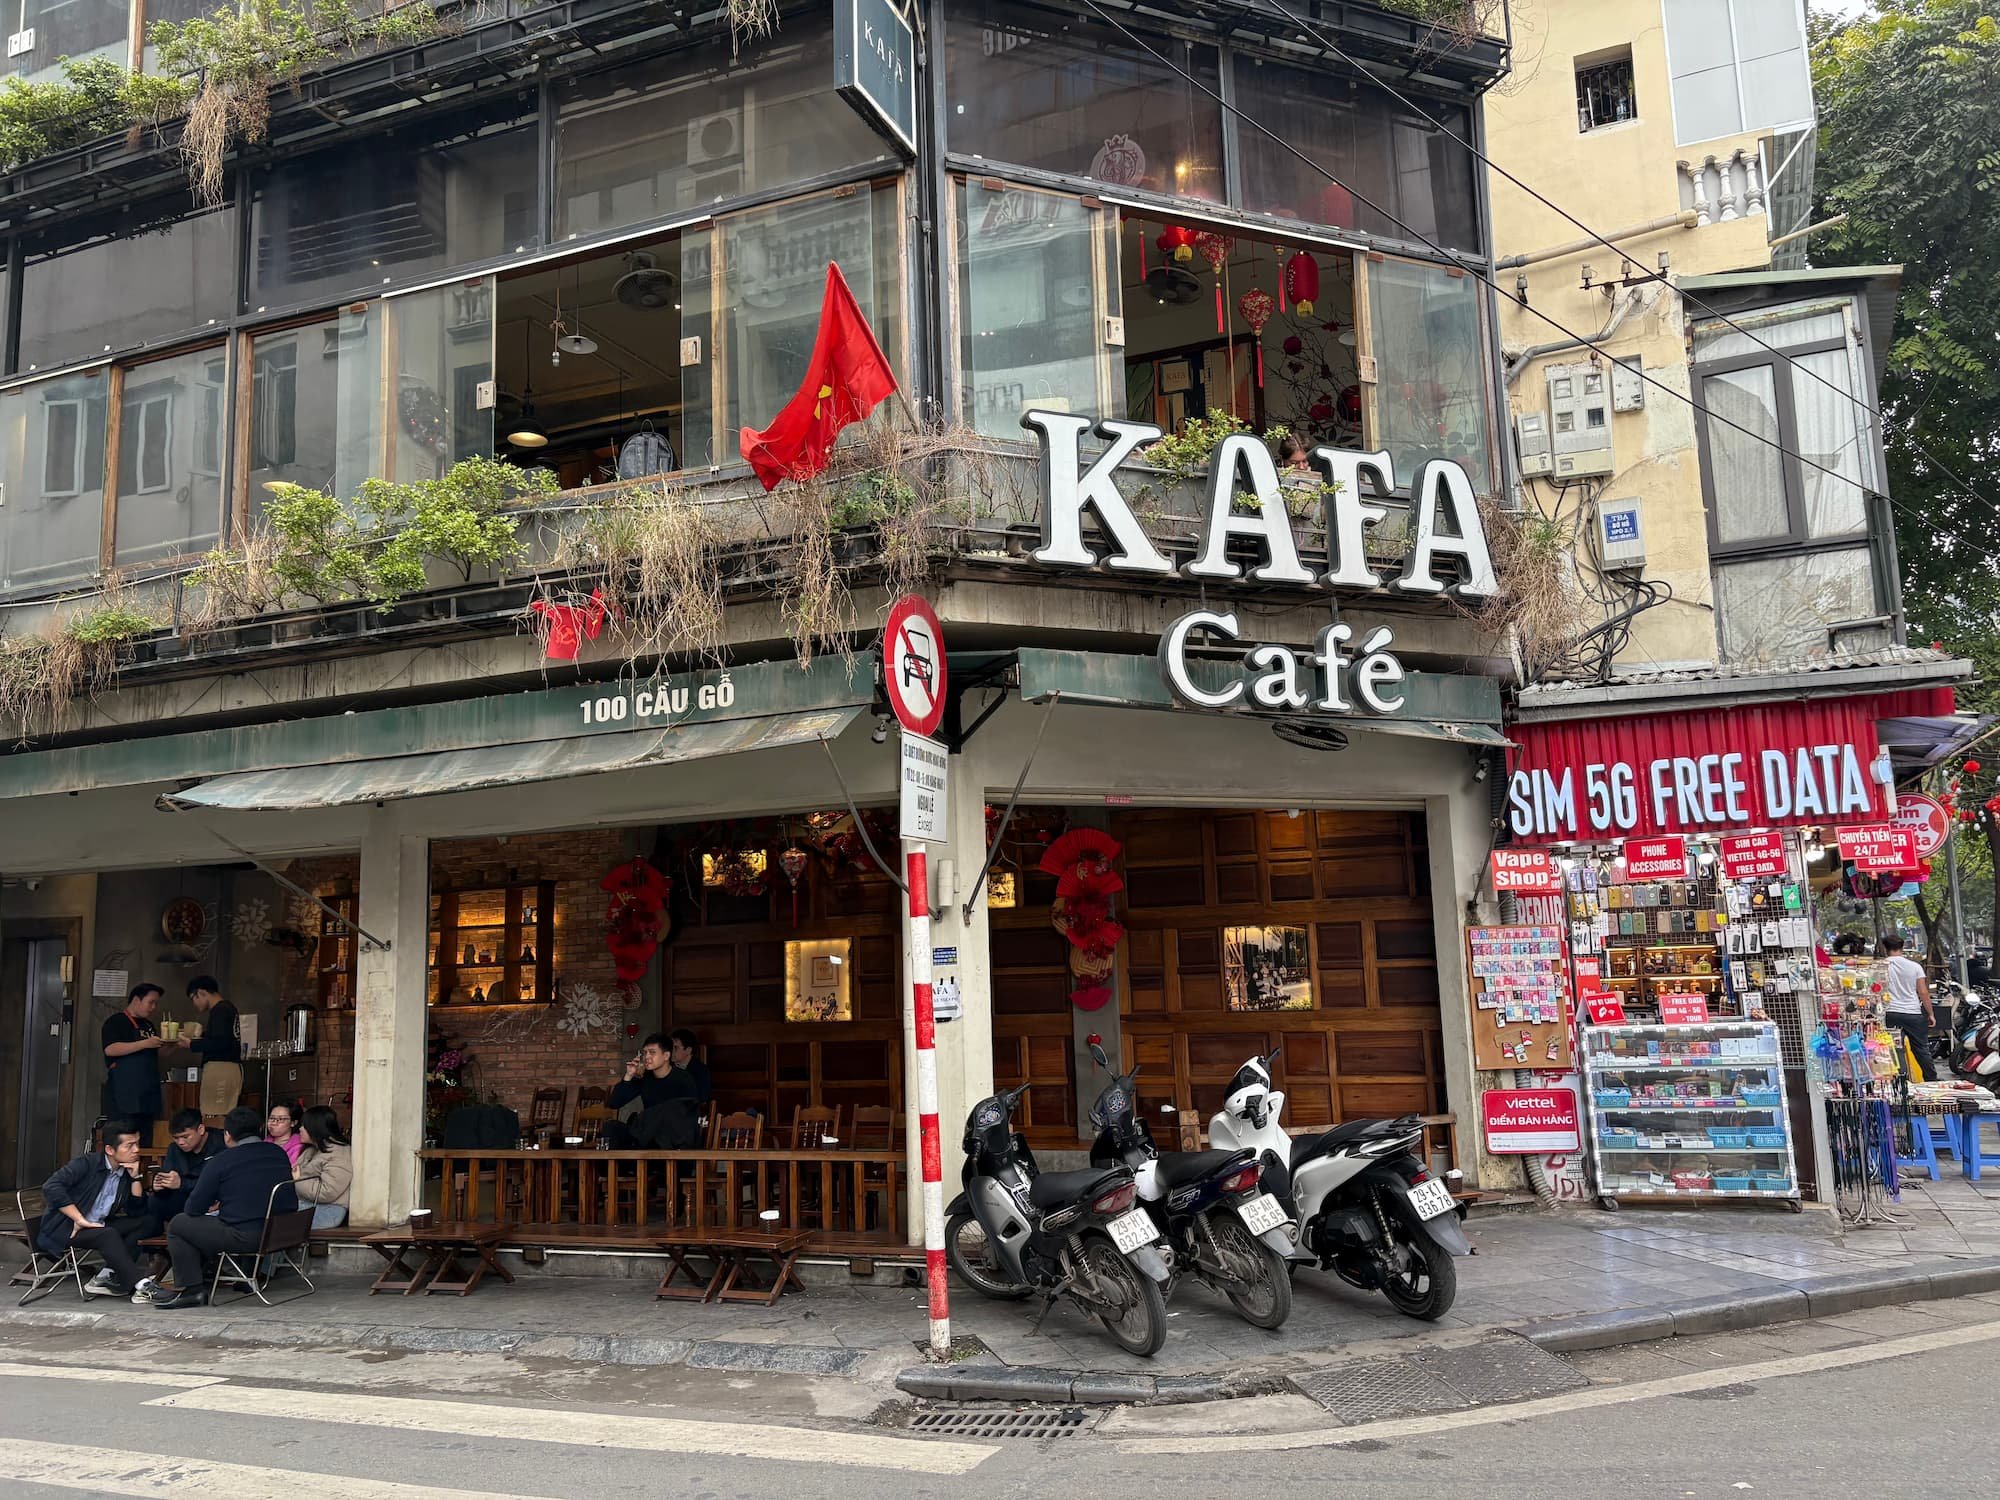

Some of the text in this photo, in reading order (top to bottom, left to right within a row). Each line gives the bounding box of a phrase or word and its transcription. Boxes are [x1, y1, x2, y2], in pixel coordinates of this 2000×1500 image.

[1022, 408, 1499, 597] KAFA
[1163, 609, 1406, 714] Café
[580, 673, 735, 724] 100 CẦU GỖ
[1510, 742, 1871, 837] SIM 5G FREE DATA
[1893, 806, 1920, 820] im
[918, 815, 933, 834] Except
[1641, 844, 1668, 857] PHONE
[1735, 837, 1768, 849] SIM CAR
[1854, 844, 1879, 857] 24/7
[1494, 852, 1545, 868] Vape
[1726, 848, 1781, 864] VIETTEL 4G-5G
[1629, 858, 1682, 875] ACCESSORIES
[1735, 862, 1775, 875] FREE DATA
[1495, 870, 1549, 887] Shop
[1505, 1098, 1556, 1109] viettel
[1489, 1112, 1573, 1126] ĐIỂM BÁN HÀNG
[1413, 1182, 1441, 1203] 29-K1
[1244, 1199, 1274, 1219] 29-AH
[1418, 1194, 1453, 1217] 936.78
[1114, 1213, 1146, 1236] 29-H1
[1250, 1208, 1285, 1233] 015.95
[1118, 1224, 1157, 1252] 932.31
